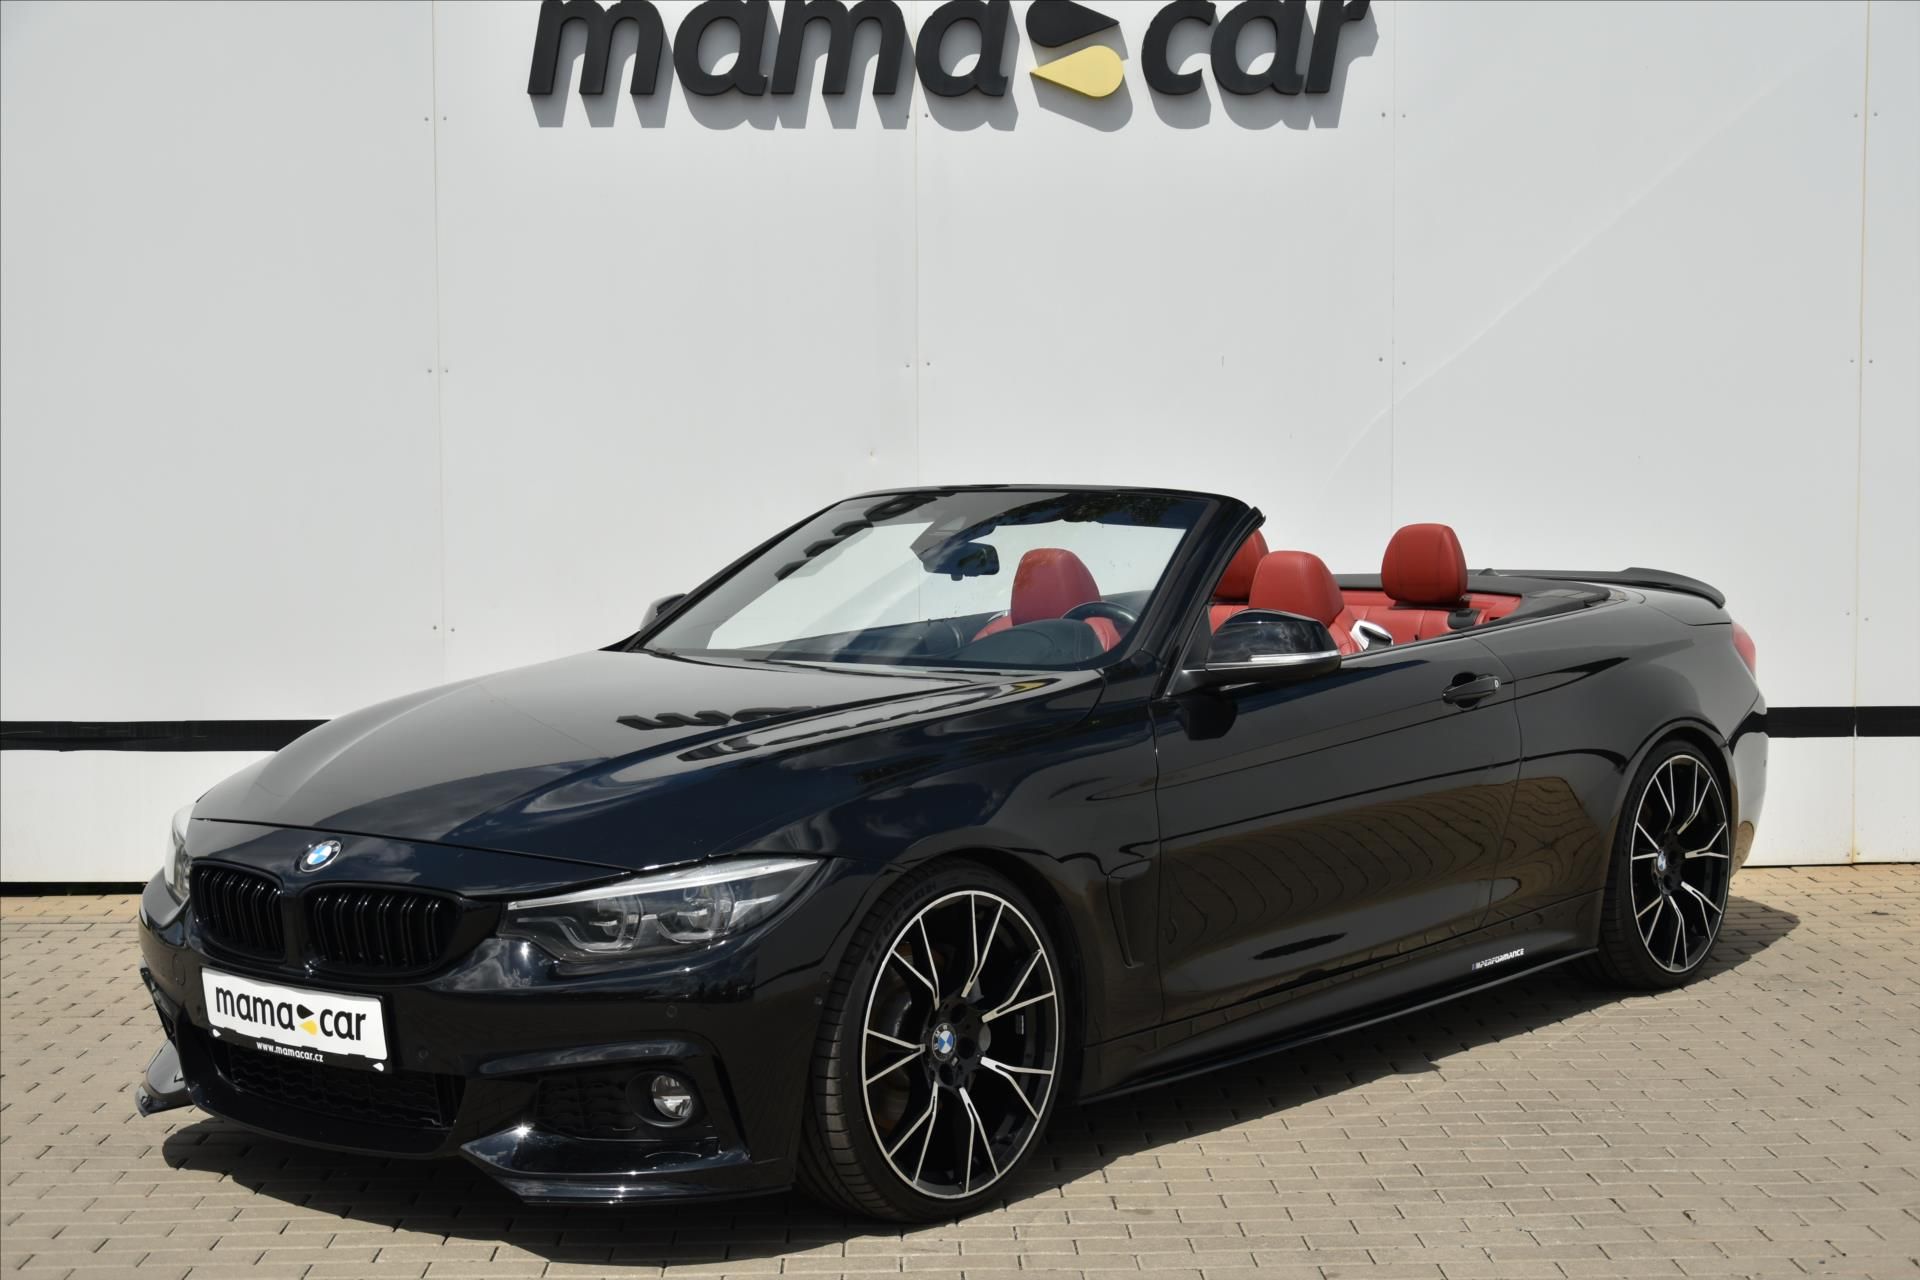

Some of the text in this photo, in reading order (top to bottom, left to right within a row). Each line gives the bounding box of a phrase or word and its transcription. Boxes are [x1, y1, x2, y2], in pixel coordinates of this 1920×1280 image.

[527, 0, 1371, 97] mama car
[215, 986, 366, 1041] mama car
[256, 1041, 324, 1063] www.mamacar.cz
